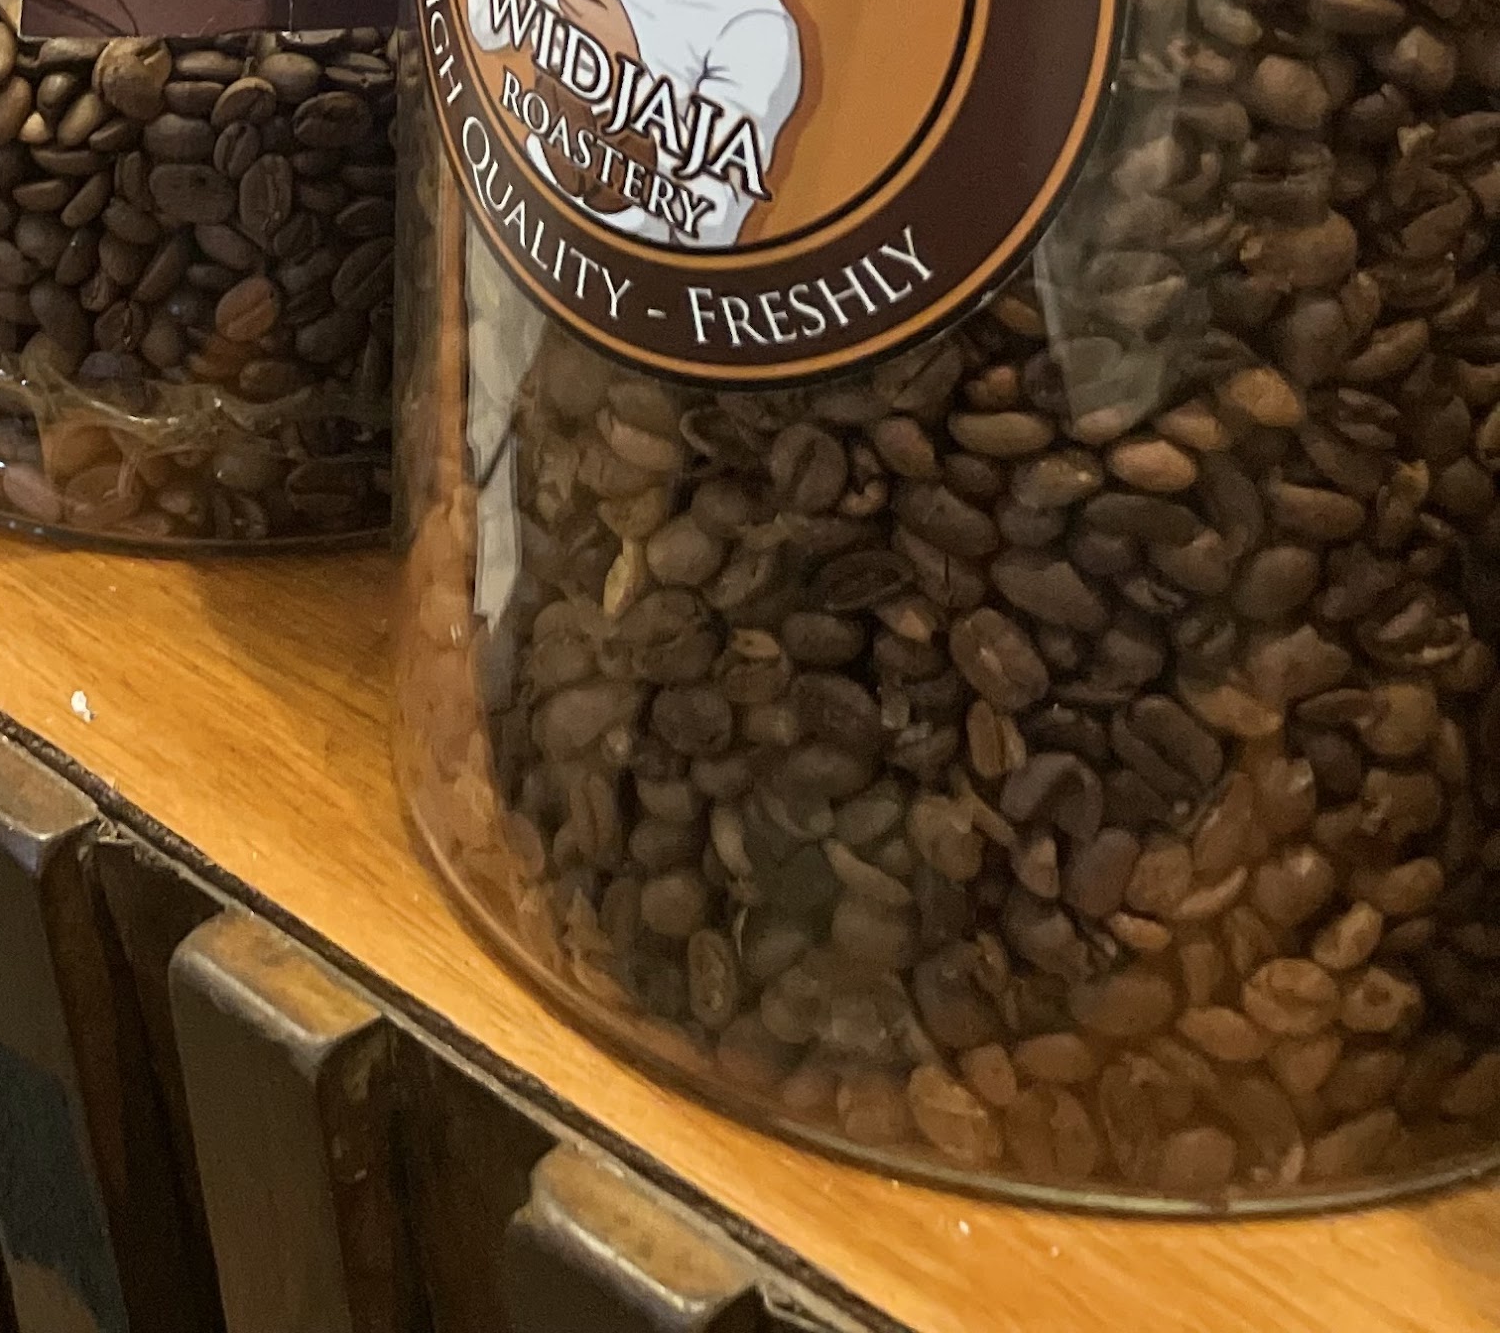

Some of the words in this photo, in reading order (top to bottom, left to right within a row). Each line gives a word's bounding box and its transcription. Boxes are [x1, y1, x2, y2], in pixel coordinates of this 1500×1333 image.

[461, 115, 632, 321] QUALITY
[686, 225, 936, 348] FRESHLY
[501, 69, 717, 237] ROASTERY
